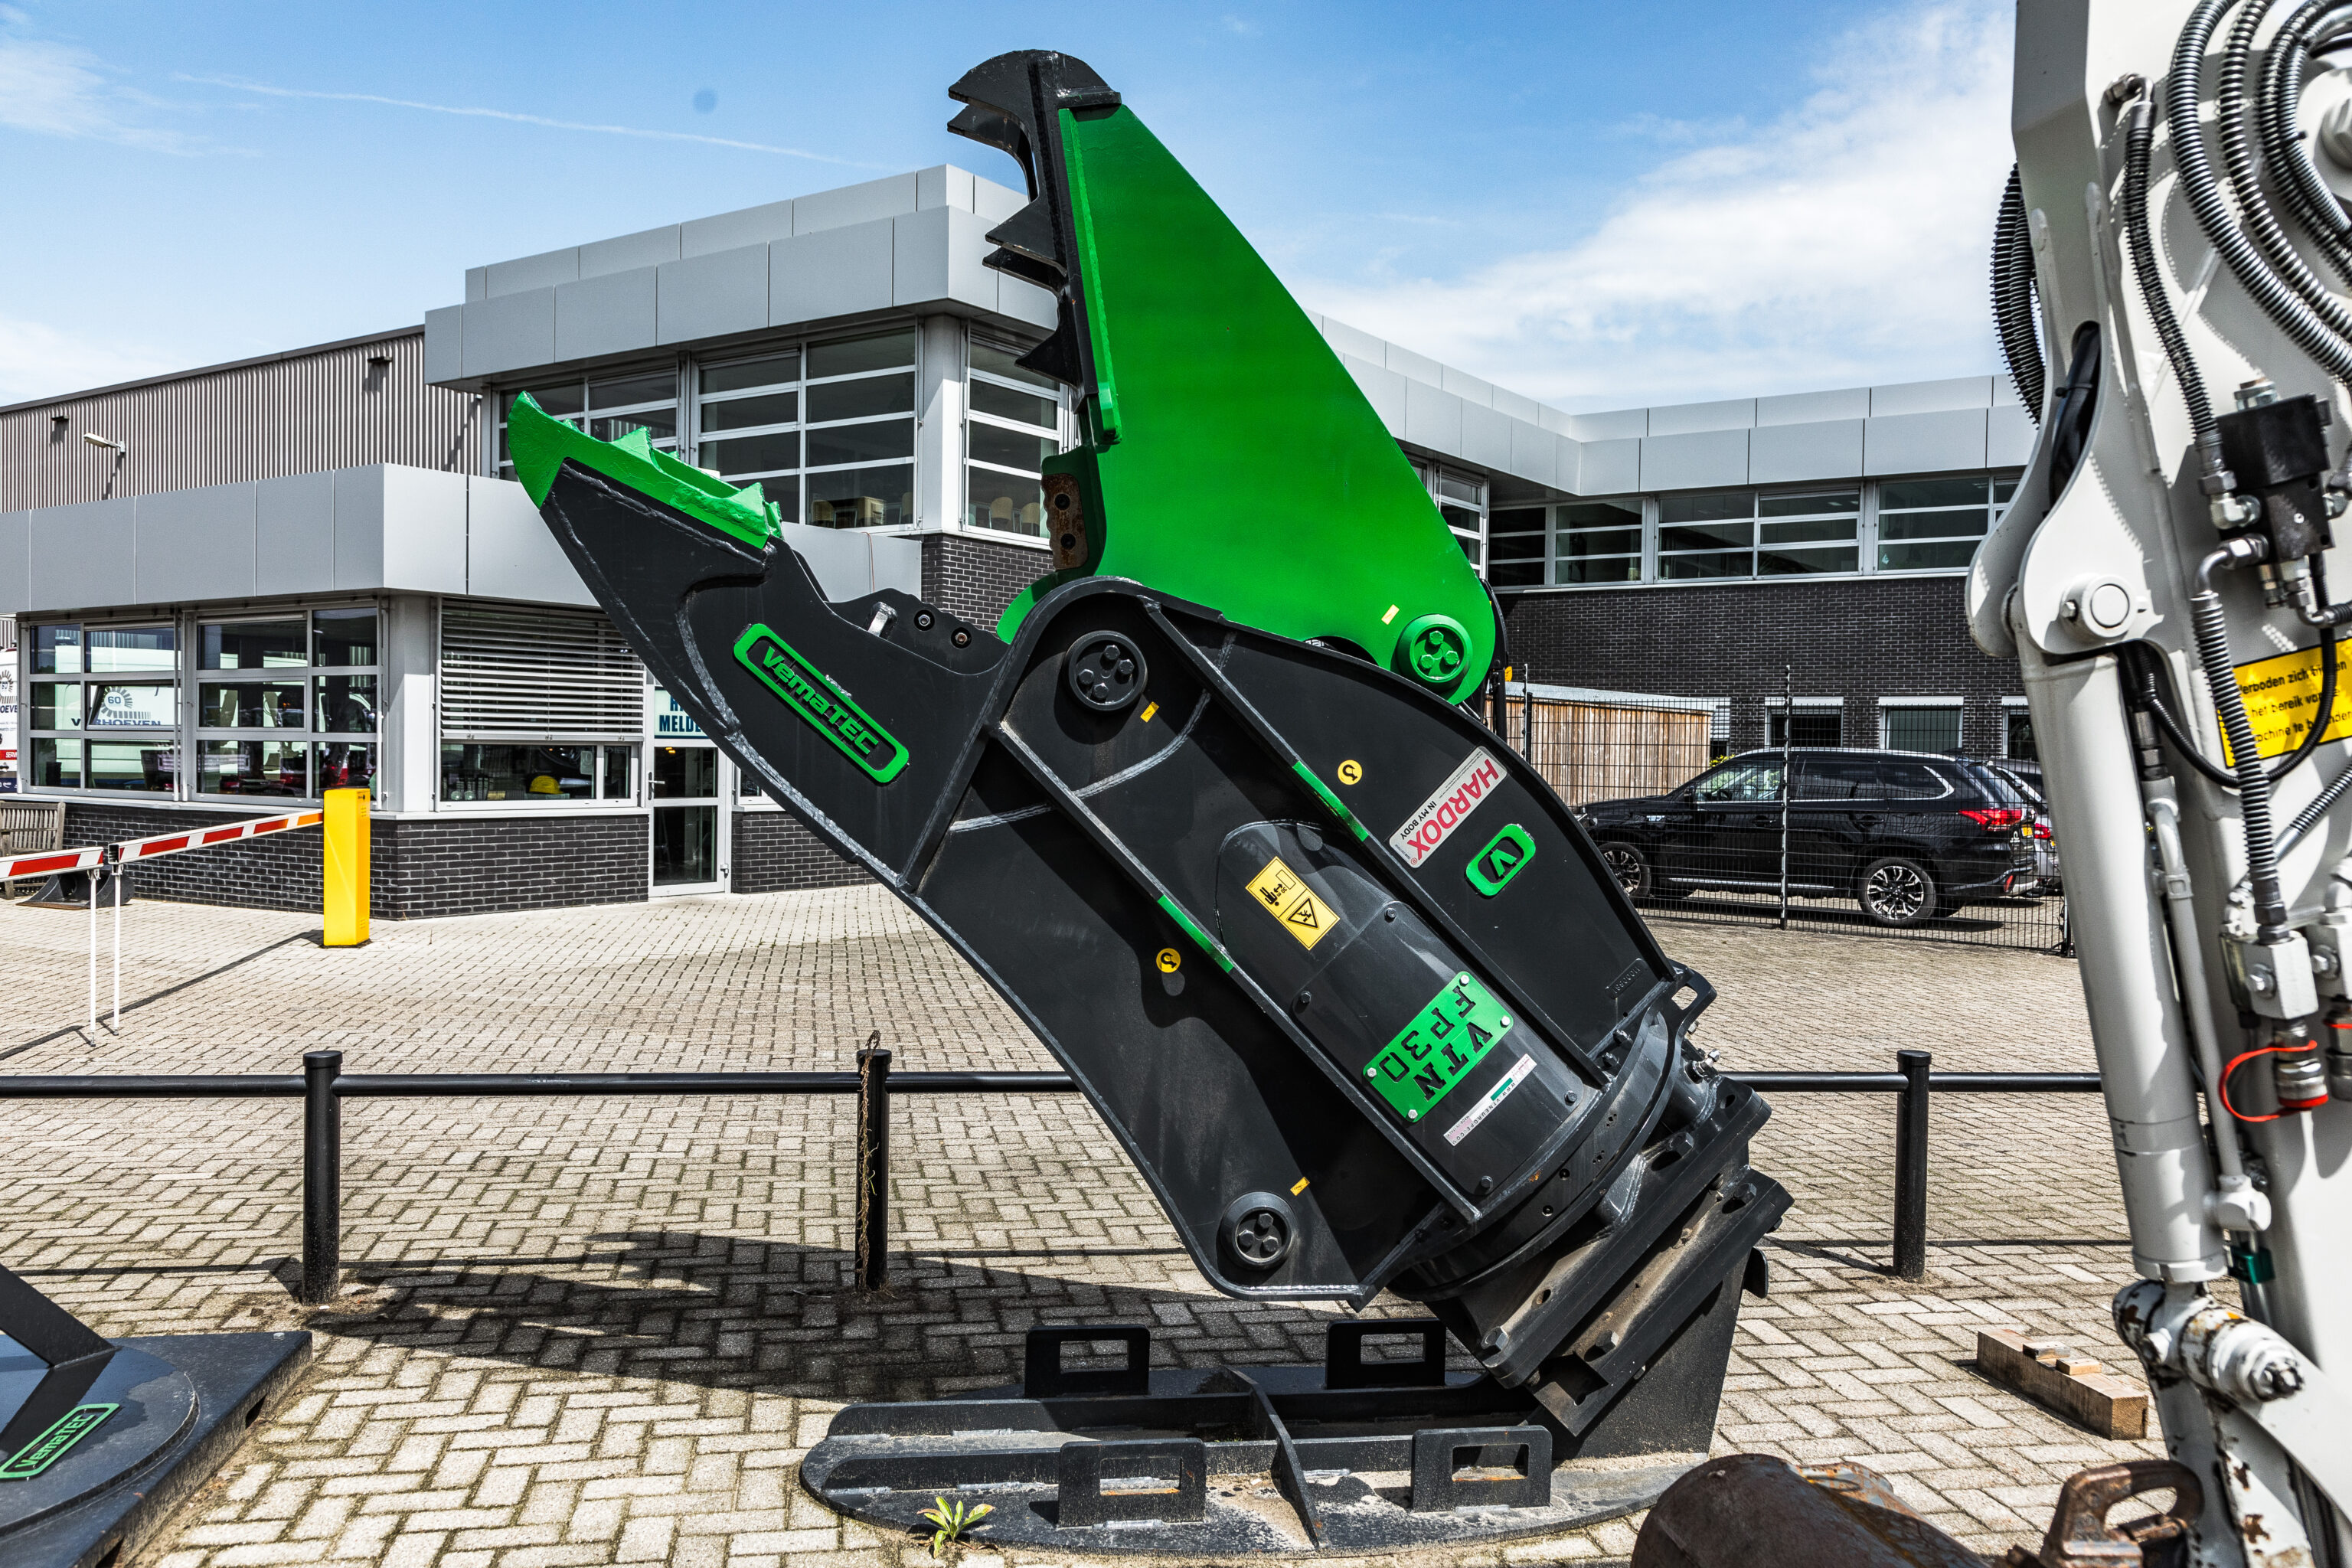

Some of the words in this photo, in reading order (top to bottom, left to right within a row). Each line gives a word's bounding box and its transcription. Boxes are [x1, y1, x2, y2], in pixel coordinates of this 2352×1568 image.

[2288, 668, 2308, 683] zich
[107, 696, 122, 704] 60
[2271, 695, 2304, 714] bereik
[2256, 727, 2292, 742] achine
[2293, 722, 2305, 733] te
[1407, 758, 1499, 861] HARDOX
[1418, 808, 1429, 822] MY
[1430, 800, 1437, 811] IN
[1400, 818, 1419, 840] BODY
[1413, 1022, 1493, 1102] VTN
